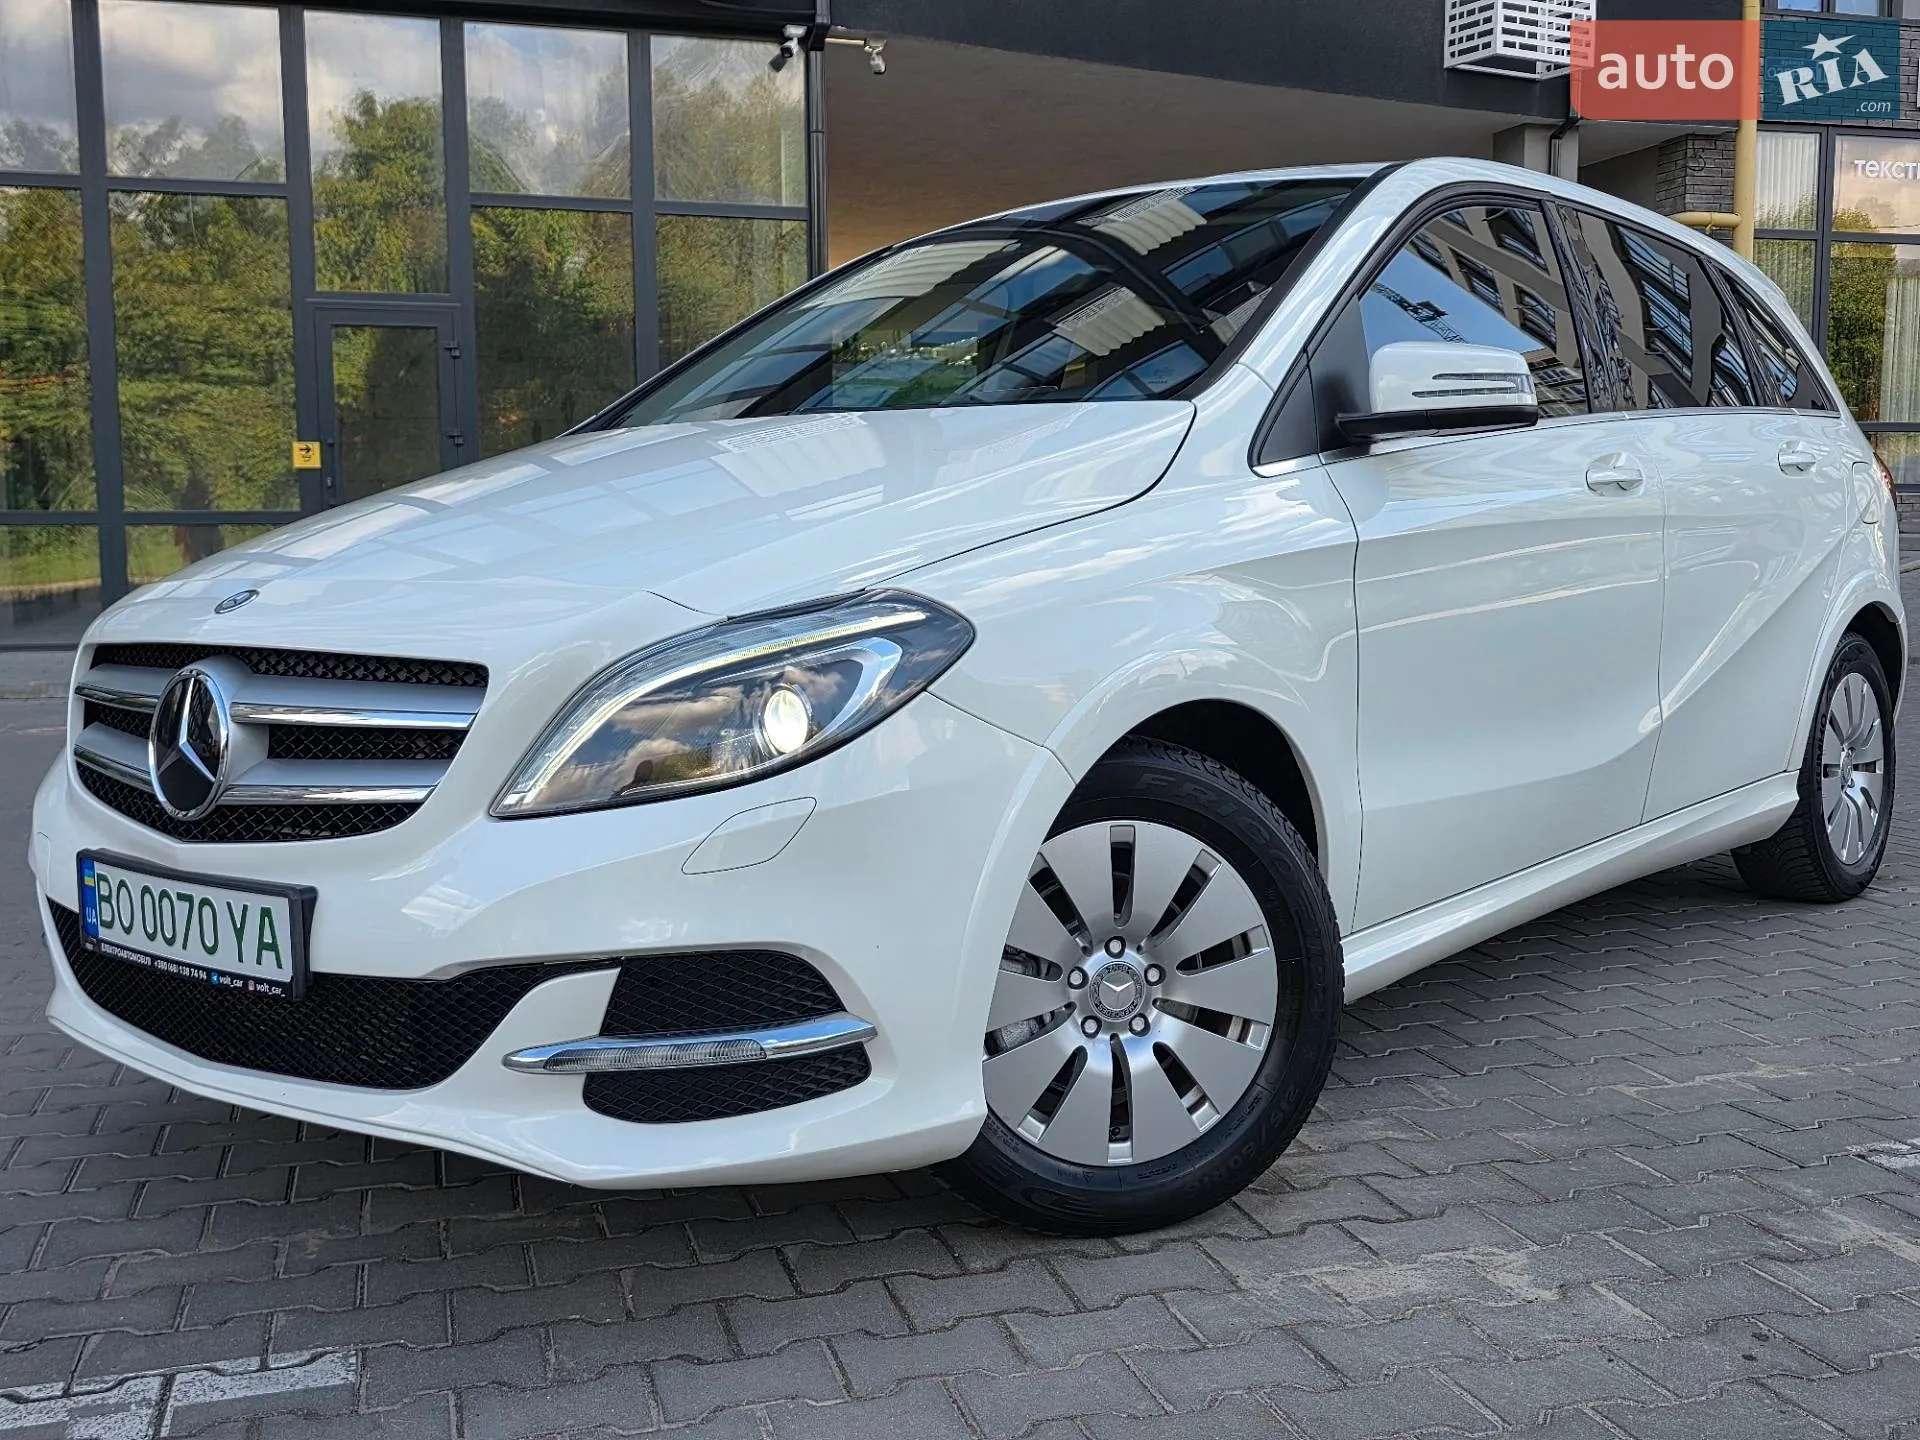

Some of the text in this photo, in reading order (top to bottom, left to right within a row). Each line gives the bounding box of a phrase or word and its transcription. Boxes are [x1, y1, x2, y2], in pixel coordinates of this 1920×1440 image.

[86, 907, 97, 925] UA
[96, 871, 283, 970] BO 0070 YA
